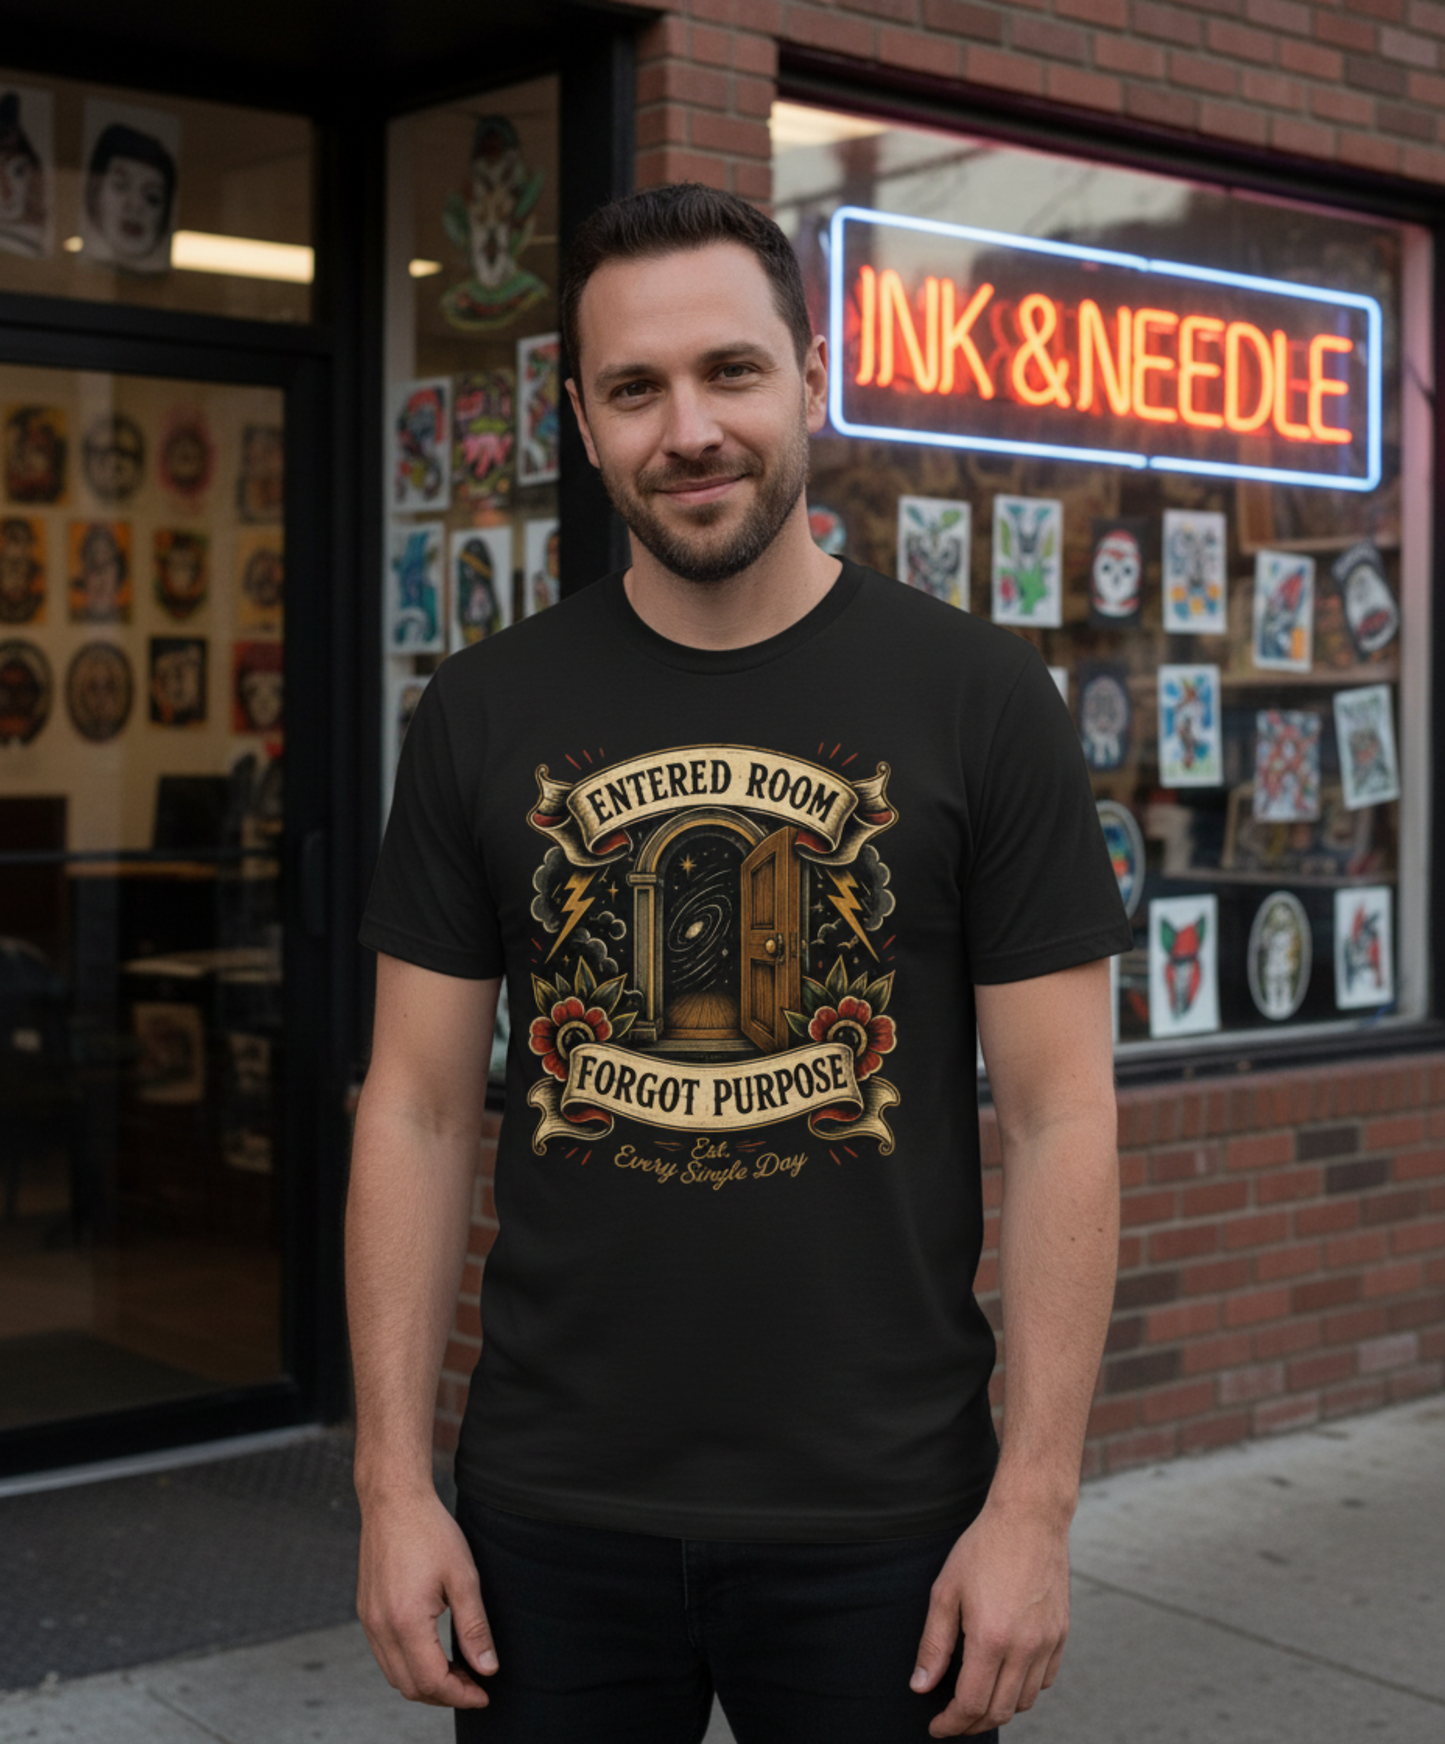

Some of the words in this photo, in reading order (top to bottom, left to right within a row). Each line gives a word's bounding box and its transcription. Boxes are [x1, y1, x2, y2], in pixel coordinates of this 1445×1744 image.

[855, 265, 996, 400] INK
[1012, 293, 1072, 409] &
[1075, 299, 1354, 444] NEEDLE
[586, 760, 732, 825] ENTERED
[746, 763, 840, 823] ROOM
[577, 1056, 700, 1116] FORGOT
[713, 1054, 848, 1116] PURPOSE
[614, 1144, 678, 1184] Every
[680, 1160, 748, 1191] Single
[753, 1152, 808, 1178] Day
[691, 1137, 730, 1160] Est.
